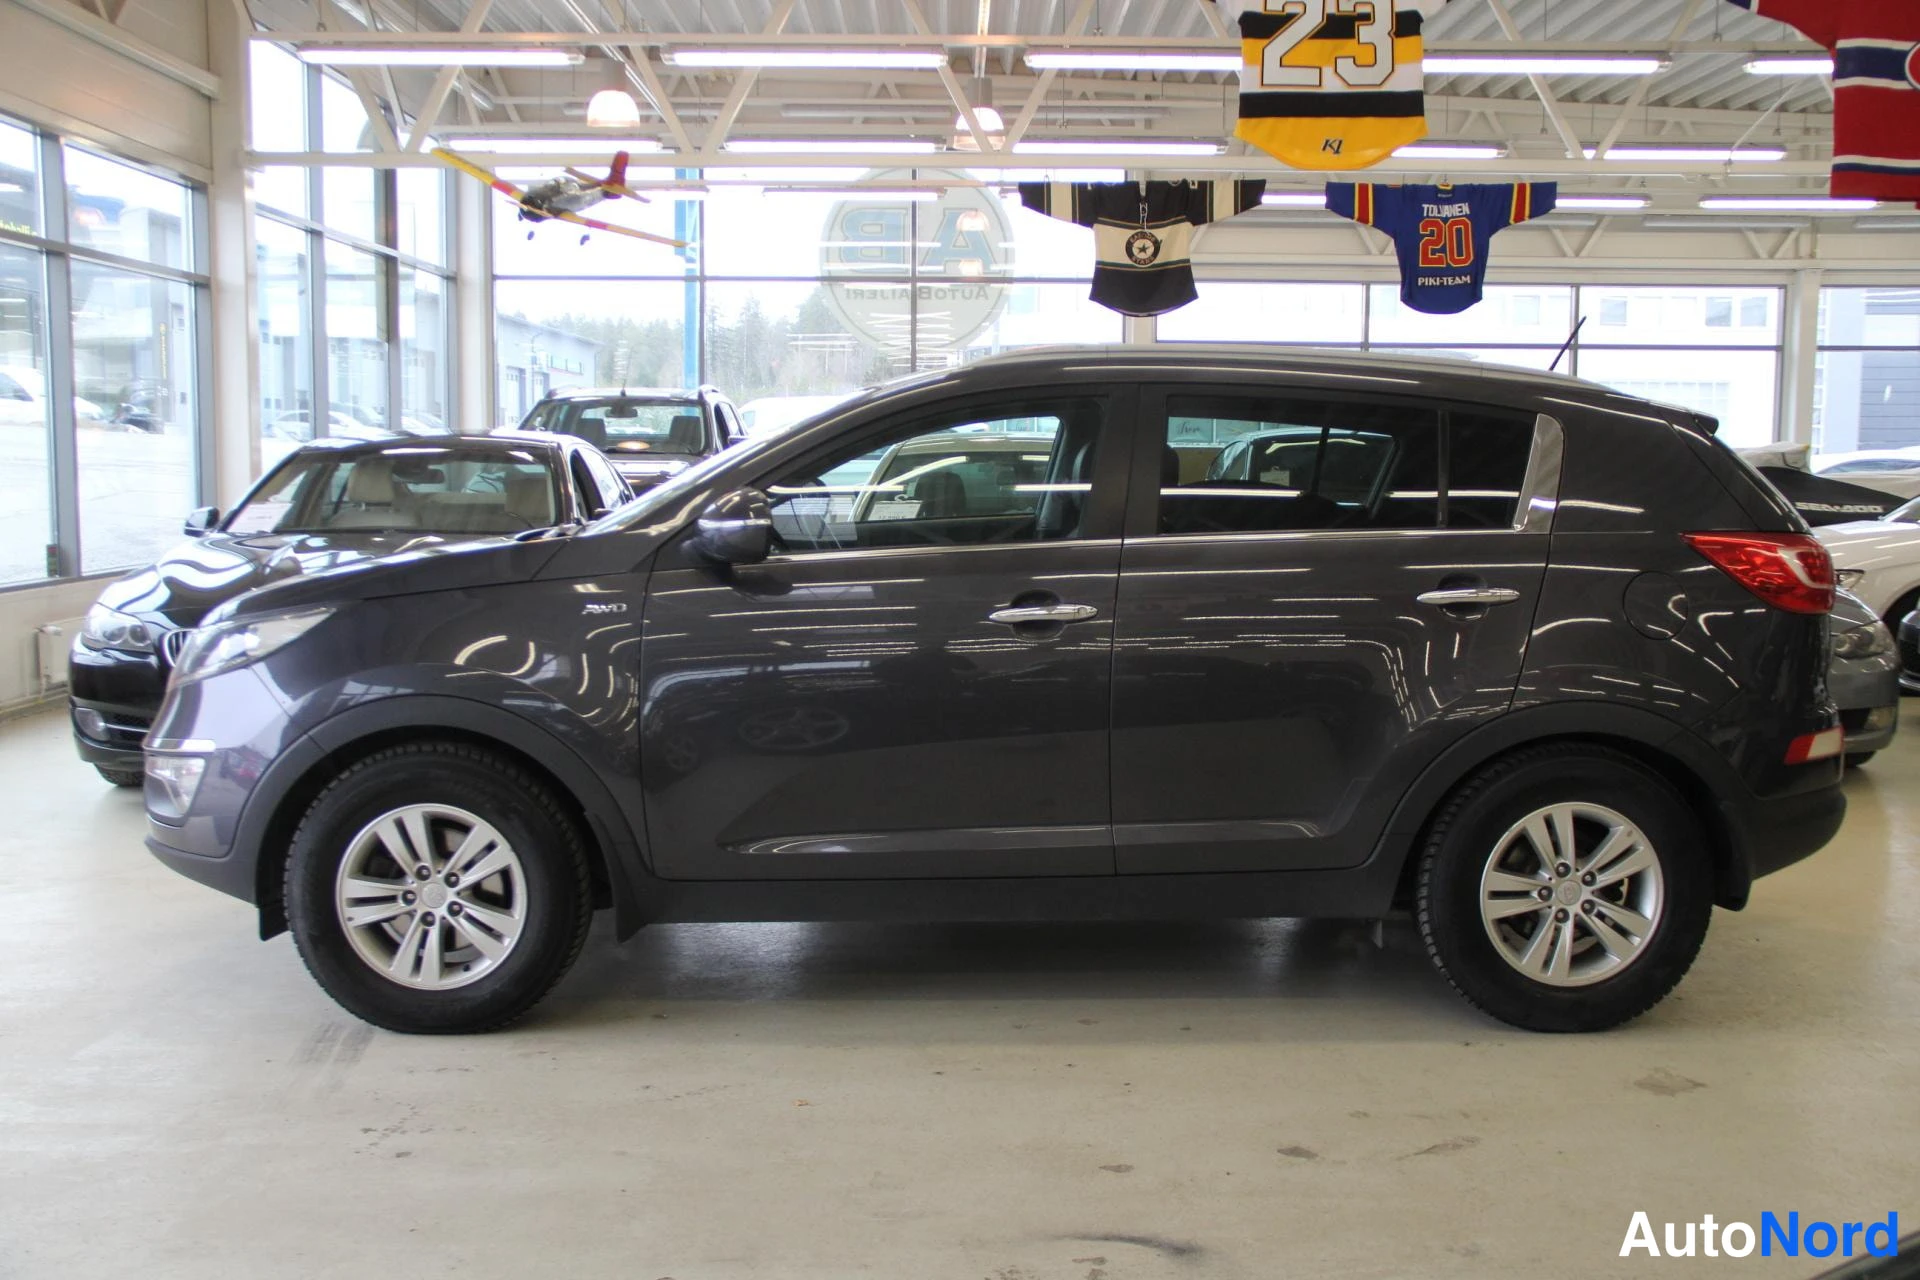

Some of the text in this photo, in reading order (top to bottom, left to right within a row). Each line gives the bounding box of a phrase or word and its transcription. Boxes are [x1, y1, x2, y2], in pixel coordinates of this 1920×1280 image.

[1262, 0, 1395, 88] 23
[1422, 203, 1470, 217] TOLVANEN
[1420, 217, 1473, 267] 20
[1418, 275, 1471, 286] PIKI-TEAM
[582, 603, 627, 614] AWD
